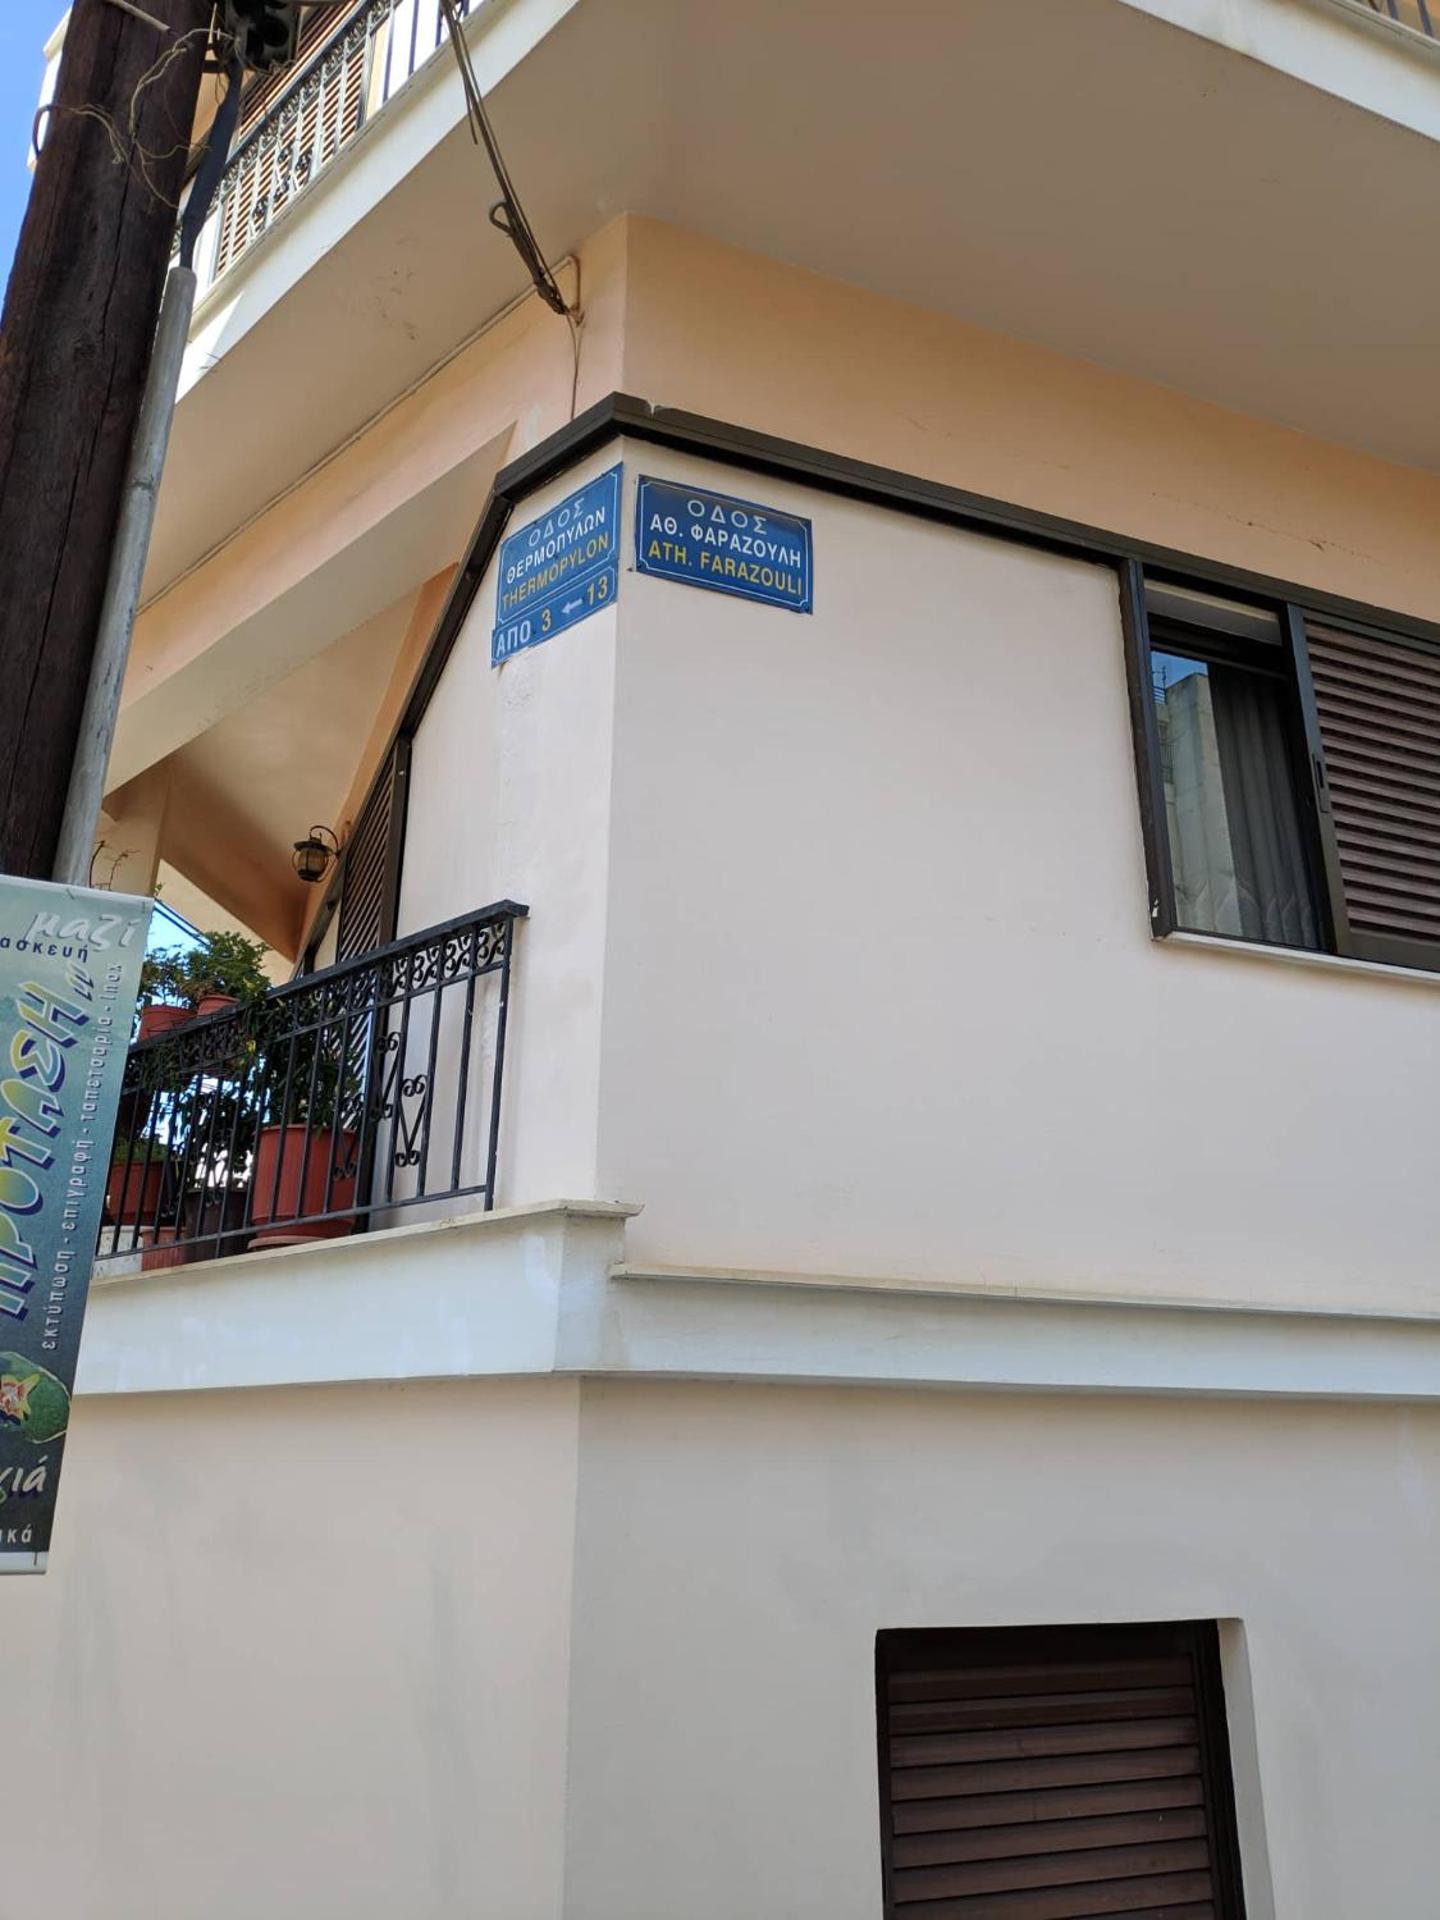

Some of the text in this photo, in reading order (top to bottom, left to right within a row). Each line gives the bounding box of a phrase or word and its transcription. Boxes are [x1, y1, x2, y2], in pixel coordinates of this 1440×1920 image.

[506, 506, 605, 585] ΘΕΡΜΟΠΥΛΩΝ
[528, 498, 585, 547] ΟΔΟΣ
[650, 513, 801, 568] ΑΘ. ΦΑΡΑΖΟΥΛΗ
[687, 499, 767, 535] ΟΔΟΣ
[502, 531, 609, 612] THERMOPYLON
[648, 540, 802, 596] ATH. FARAZOULI
[495, 575, 608, 657] ΑΠΟ 3 13
[42, 1250, 77, 1350] εκτύπωση
[62, 1139, 95, 1230] επιγραφή
